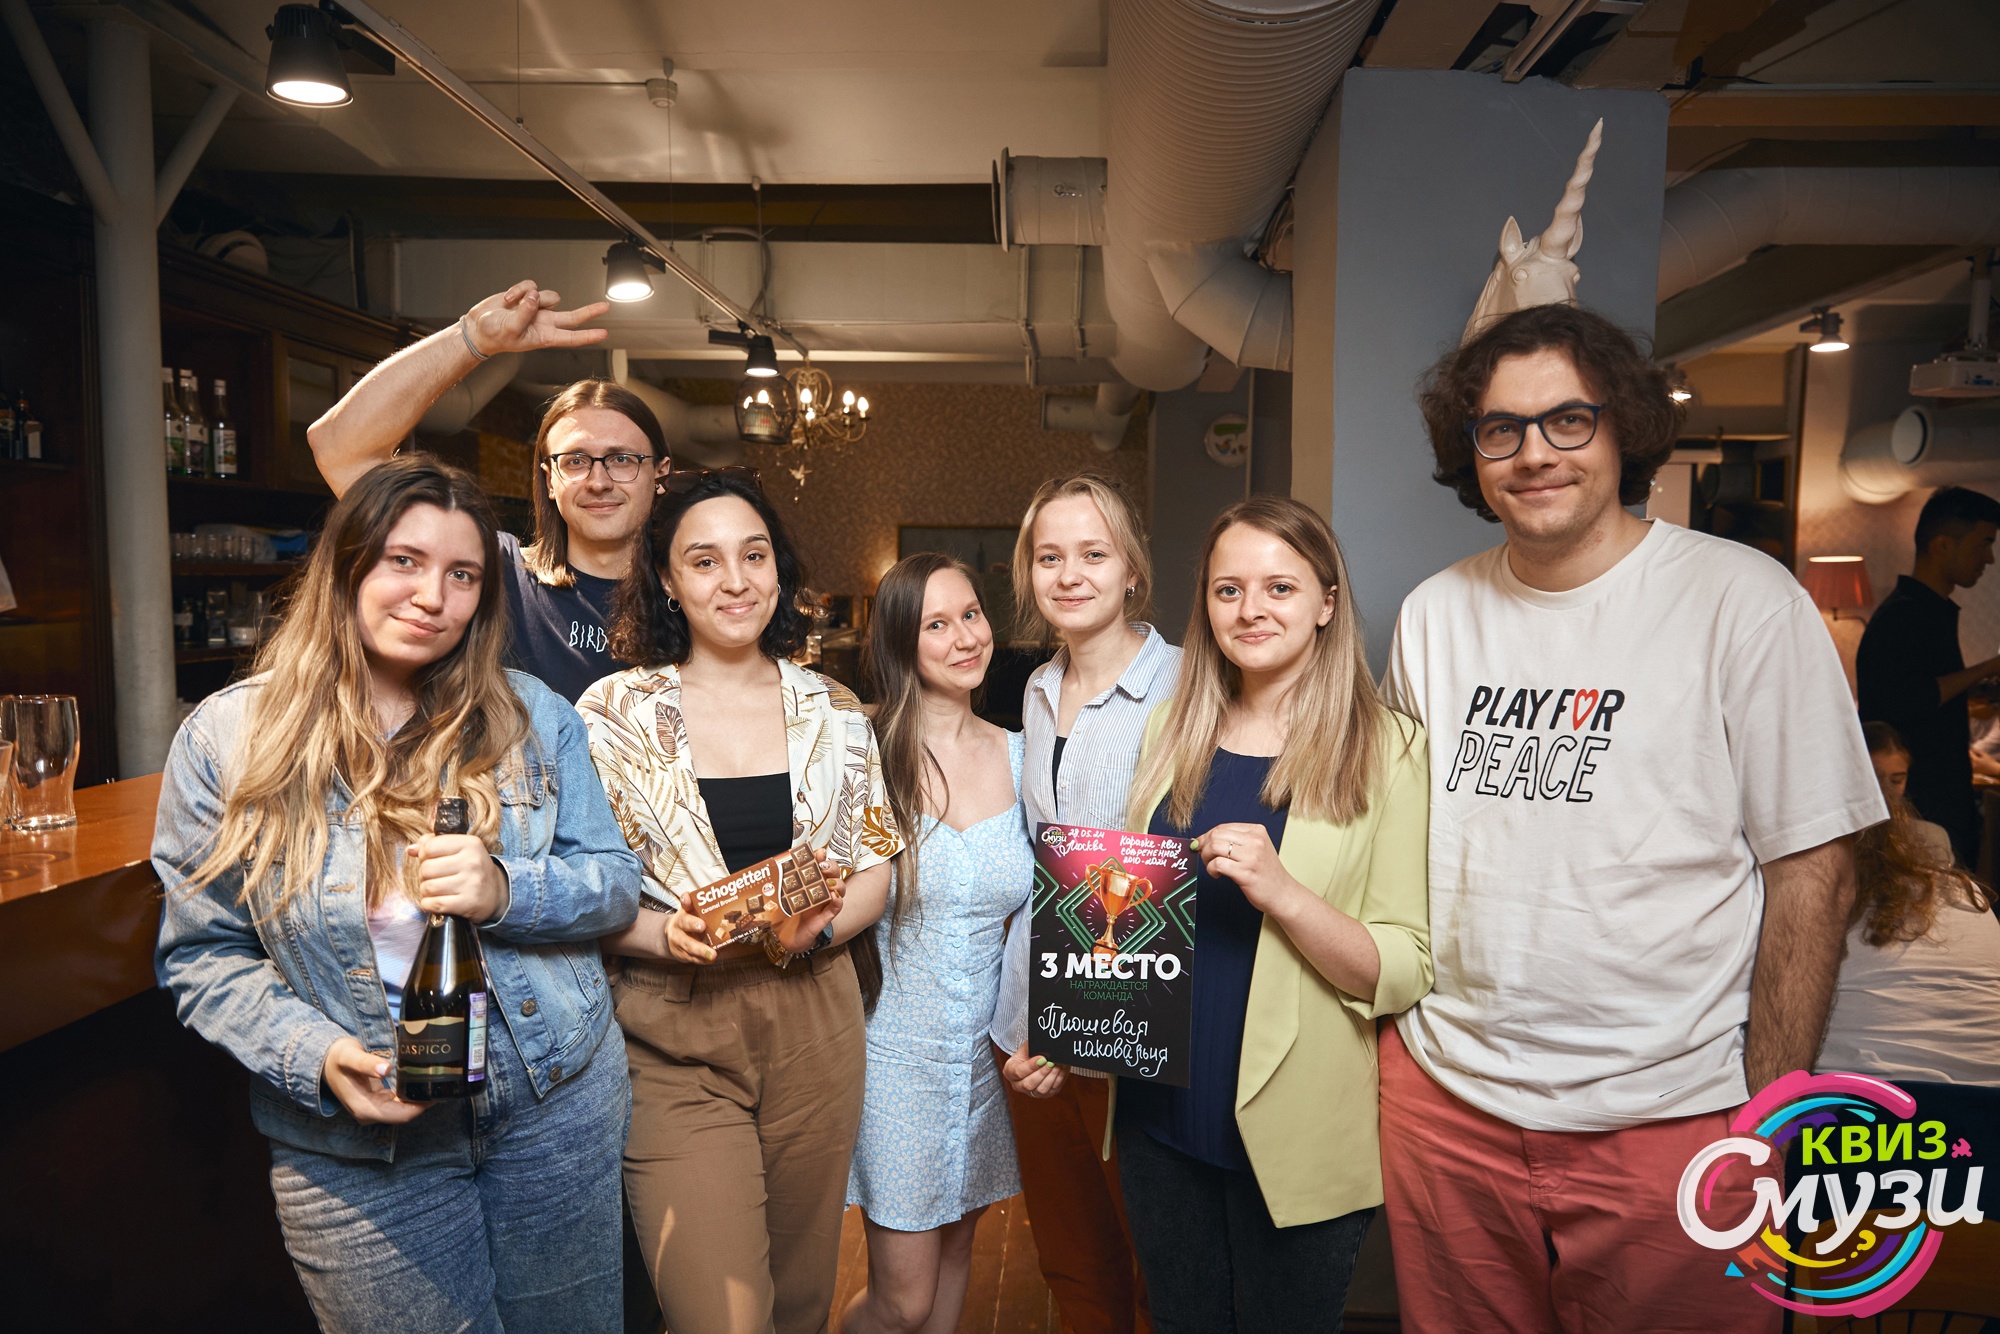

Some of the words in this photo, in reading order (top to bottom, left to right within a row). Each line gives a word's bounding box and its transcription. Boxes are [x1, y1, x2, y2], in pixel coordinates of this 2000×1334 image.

[1465, 685, 1553, 730] PLAY
[1446, 730, 1611, 802] PEACE
[1041, 831, 1067, 844] Смузи
[1068, 828, 1105, 839] 28.05.24
[696, 864, 771, 906] Schogetten
[1040, 953, 1058, 979] 3
[1065, 953, 1181, 981] МЕСТО
[1069, 980, 1148, 991] НАГРАЖДАЕТСЯ
[1083, 991, 1134, 1002] КОМАНДА
[400, 1043, 452, 1056] CASPICO
[1073, 1037, 1168, 1078] наковальня
